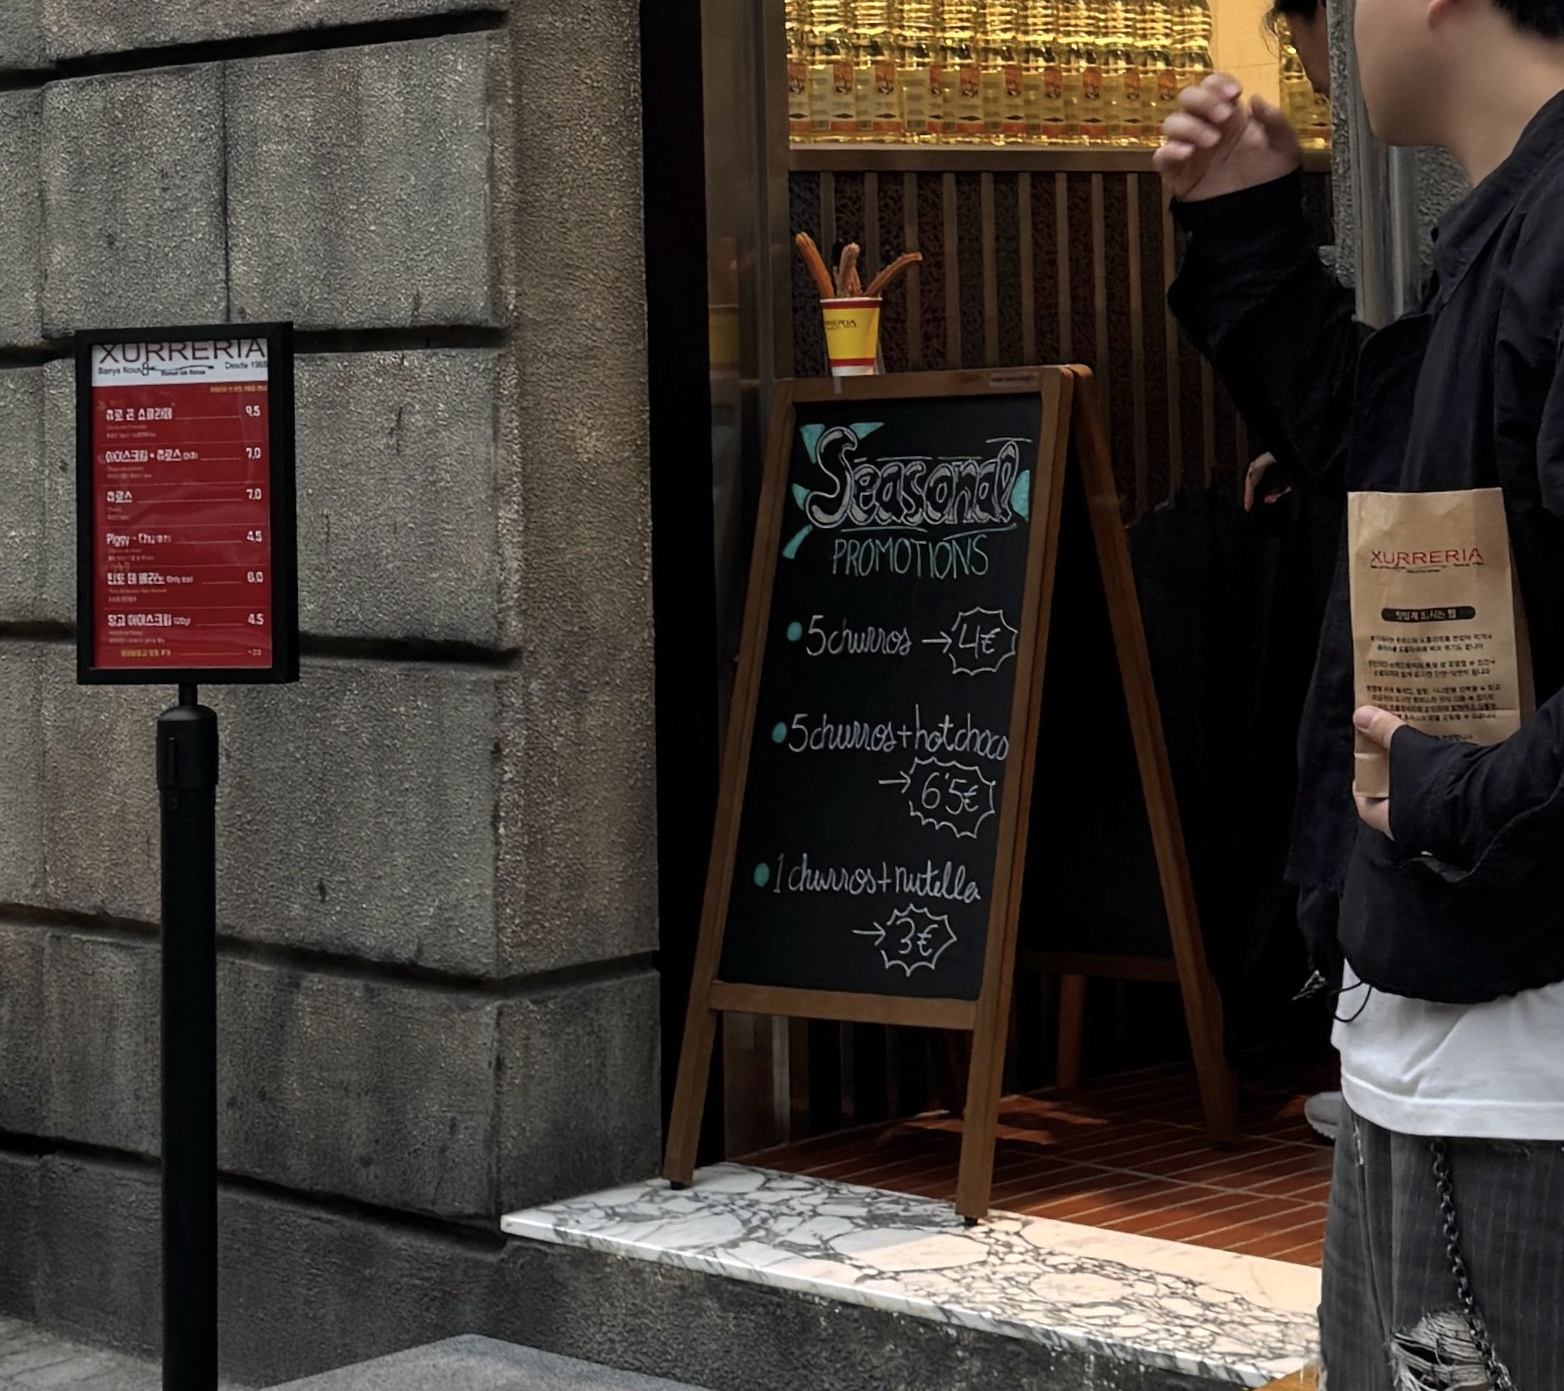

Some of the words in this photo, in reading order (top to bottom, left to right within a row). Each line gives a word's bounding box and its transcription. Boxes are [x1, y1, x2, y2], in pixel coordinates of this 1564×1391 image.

[100, 339, 265, 364] XURRERIA
[805, 426, 1019, 528] Seasonal
[832, 534, 989, 579] PROMOTIONS
[1371, 547, 1484, 565] XURRERIA
[958, 624, 1001, 659] 4€
[896, 917, 939, 956] 3€
